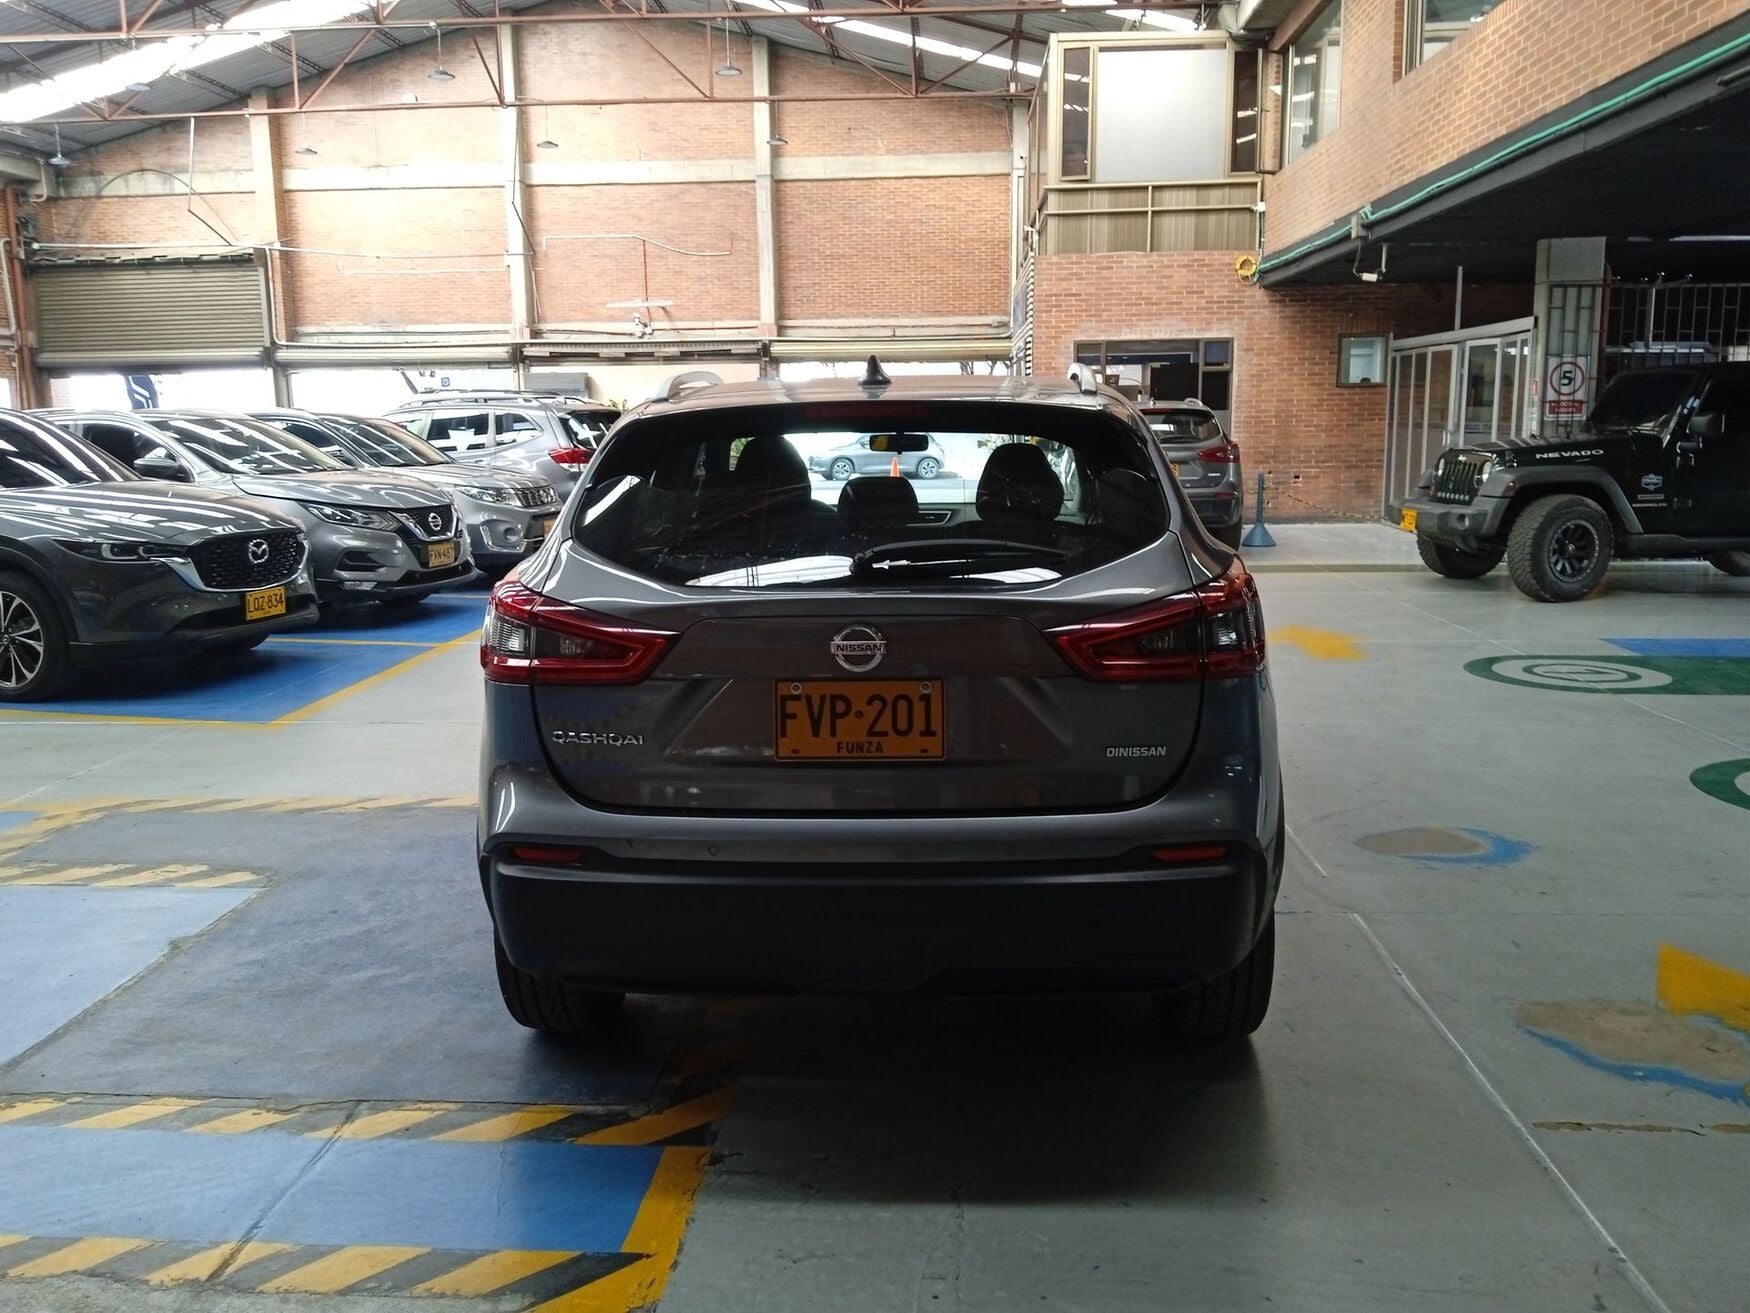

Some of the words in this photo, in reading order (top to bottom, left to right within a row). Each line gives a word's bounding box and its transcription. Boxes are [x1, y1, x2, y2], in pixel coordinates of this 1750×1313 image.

[1561, 370, 1573, 386] 5
[1535, 449, 1604, 459] NEVADO
[836, 644, 882, 652] NISSAN
[552, 731, 644, 746] QASHQAI
[836, 741, 884, 754] FUNZA
[1106, 746, 1167, 757] DINISSAN
